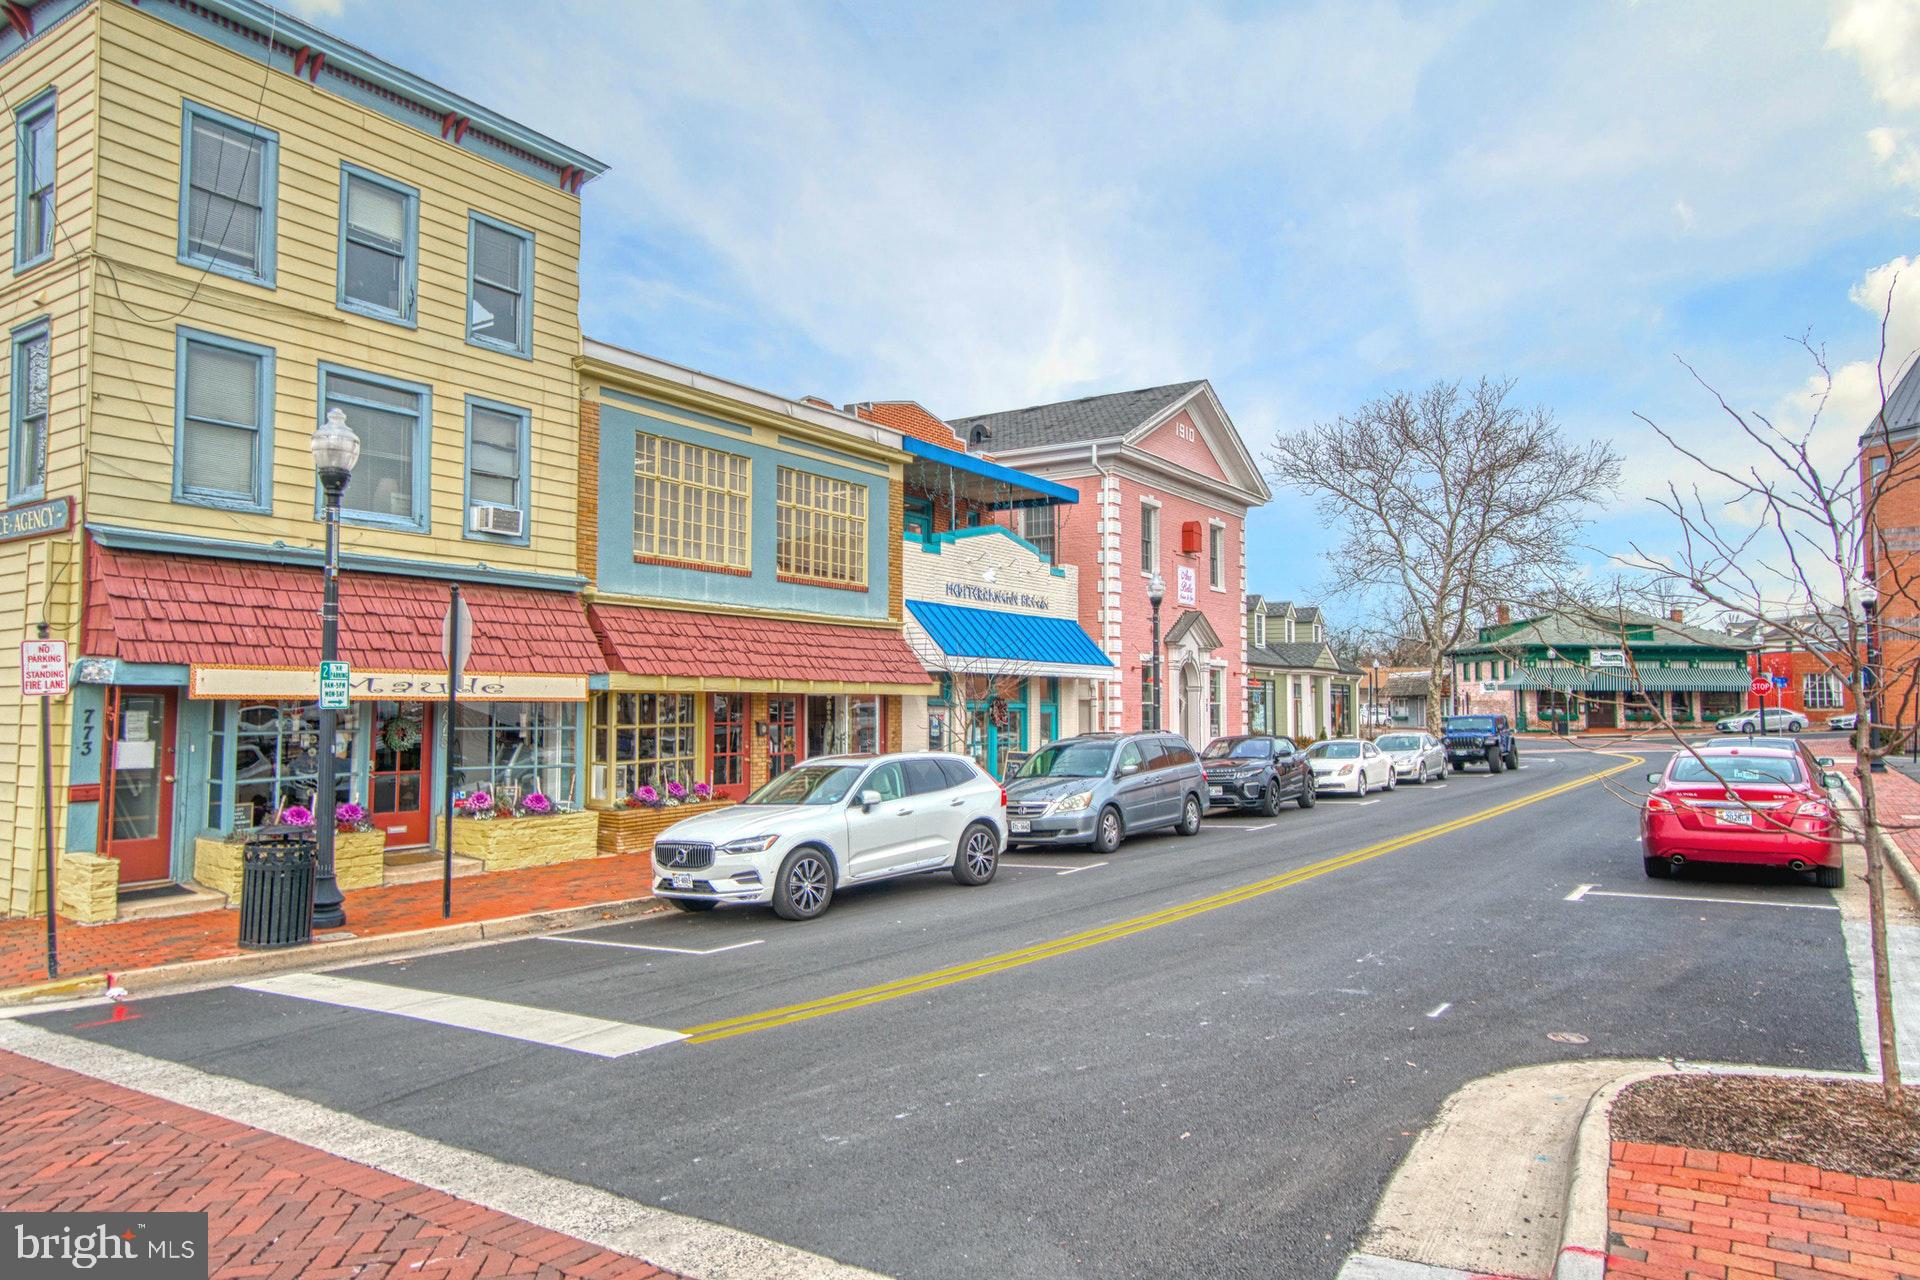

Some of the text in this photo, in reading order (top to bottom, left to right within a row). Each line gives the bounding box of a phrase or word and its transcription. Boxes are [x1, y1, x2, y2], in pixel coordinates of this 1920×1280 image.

[1176, 422, 1195, 442] 1910
[13, 506, 55, 533] AGENCY
[27, 655, 62, 663] PARKING
[25, 670, 65, 679] STANDING
[322, 665, 329, 677] 2
[25, 679, 65, 690] FIRE LANE
[1752, 683, 1770, 691] STOP
[80, 709, 96, 757] 773
